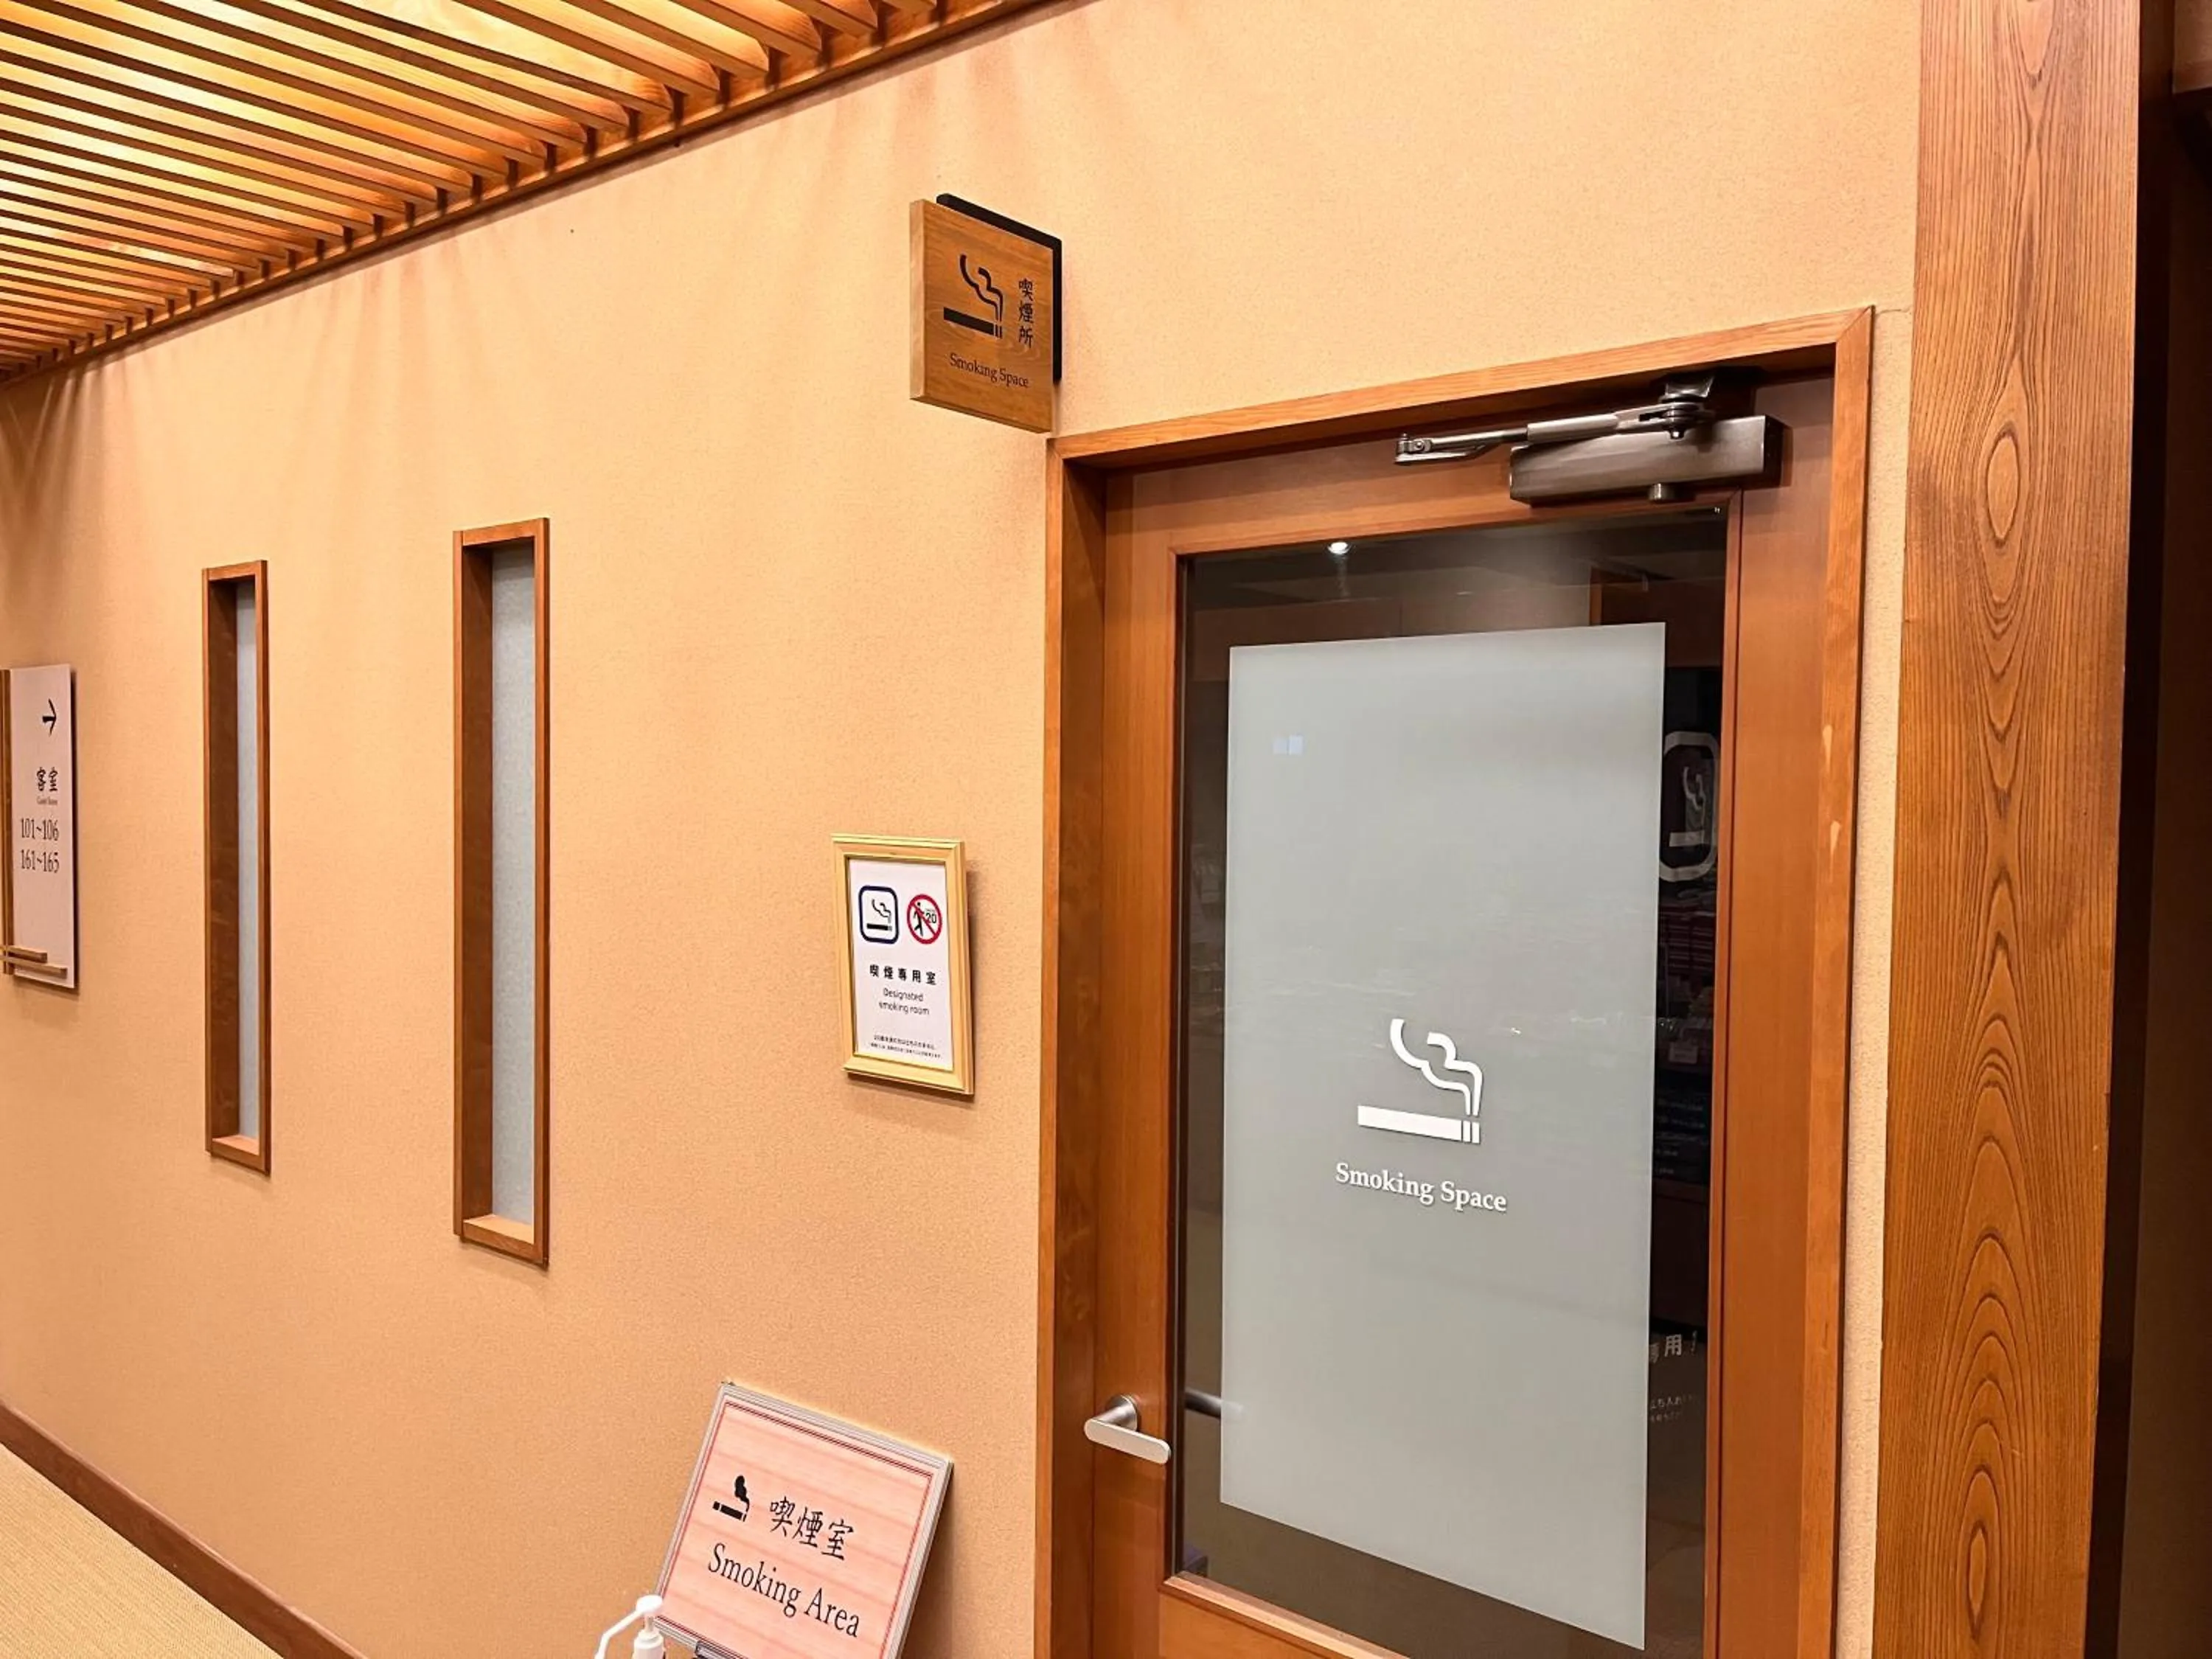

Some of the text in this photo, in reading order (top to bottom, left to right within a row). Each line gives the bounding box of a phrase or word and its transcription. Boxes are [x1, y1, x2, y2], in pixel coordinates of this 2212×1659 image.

[1018, 278, 1034, 348] 喫煙所
[950, 352, 1029, 388] Smoking Space
[36, 767, 58, 791] 客室
[870, 964, 936, 985] 喫煙専用室
[878, 1001, 930, 1015] smoking room
[883, 987, 923, 1001] Designated
[1335, 1162, 1507, 1211] Smoking Space
[769, 1495, 854, 1560] 喫煙室
[708, 1543, 860, 1638] Smoking Area
